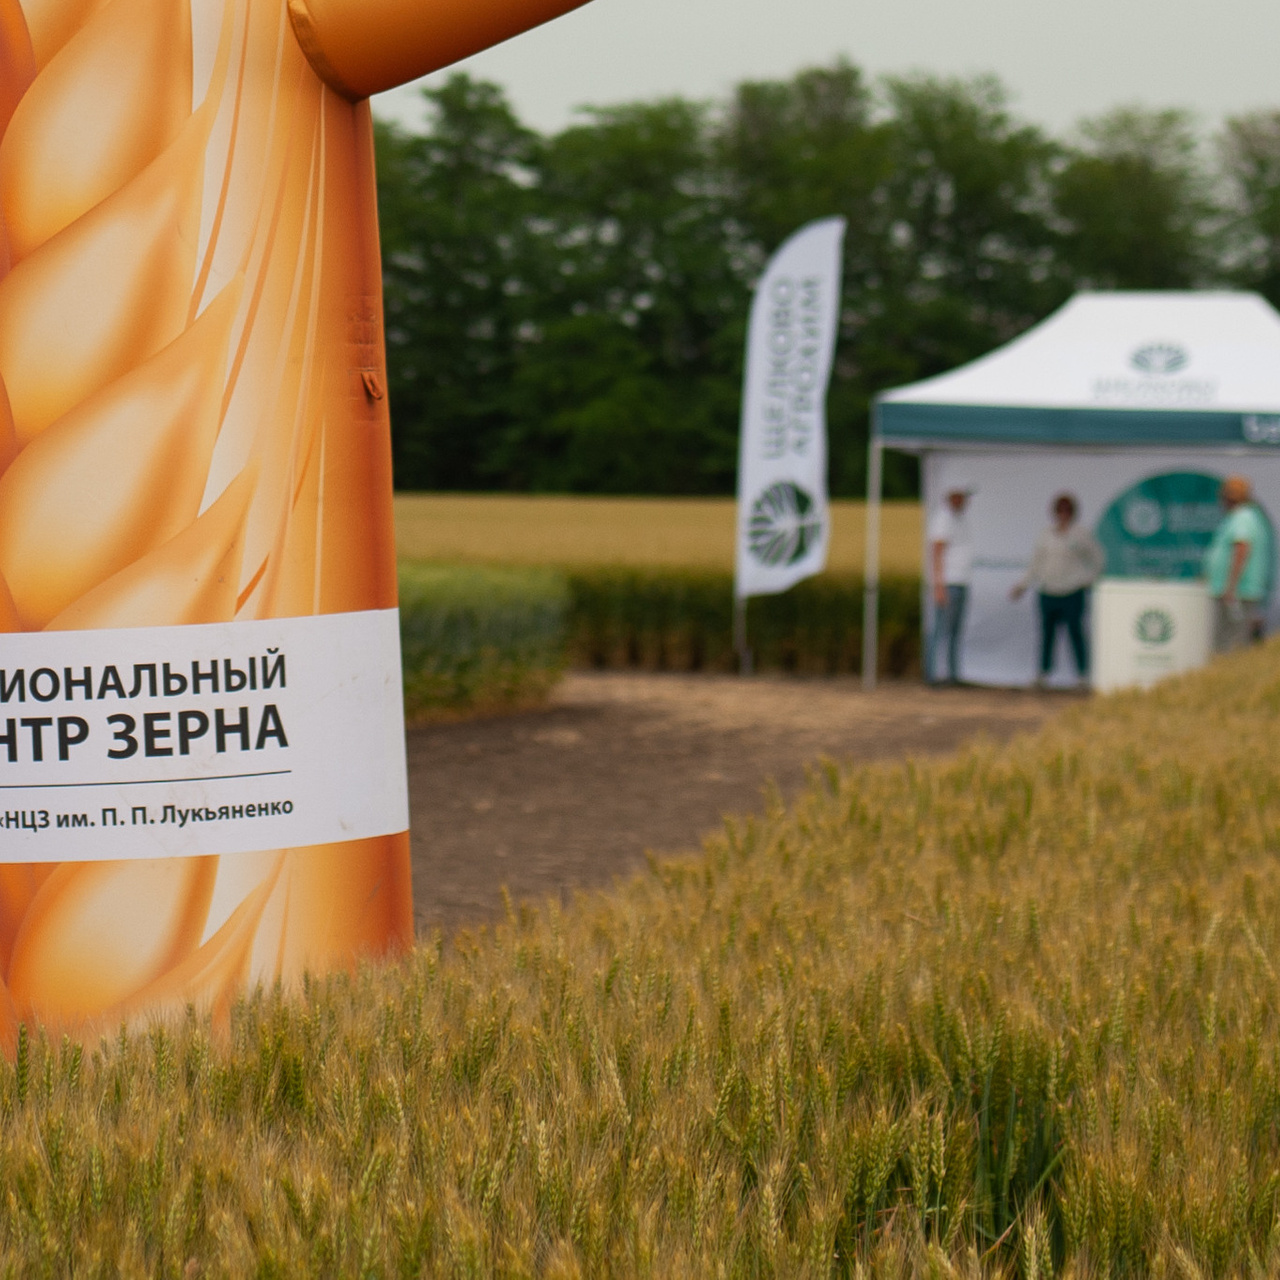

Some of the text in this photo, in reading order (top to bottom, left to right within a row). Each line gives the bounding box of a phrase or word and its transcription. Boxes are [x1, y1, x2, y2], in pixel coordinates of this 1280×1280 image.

[106, 704, 289, 760] ЗЕРНА
[56, 813, 96, 828] им.
[160, 800, 294, 828] Лукьяненко
